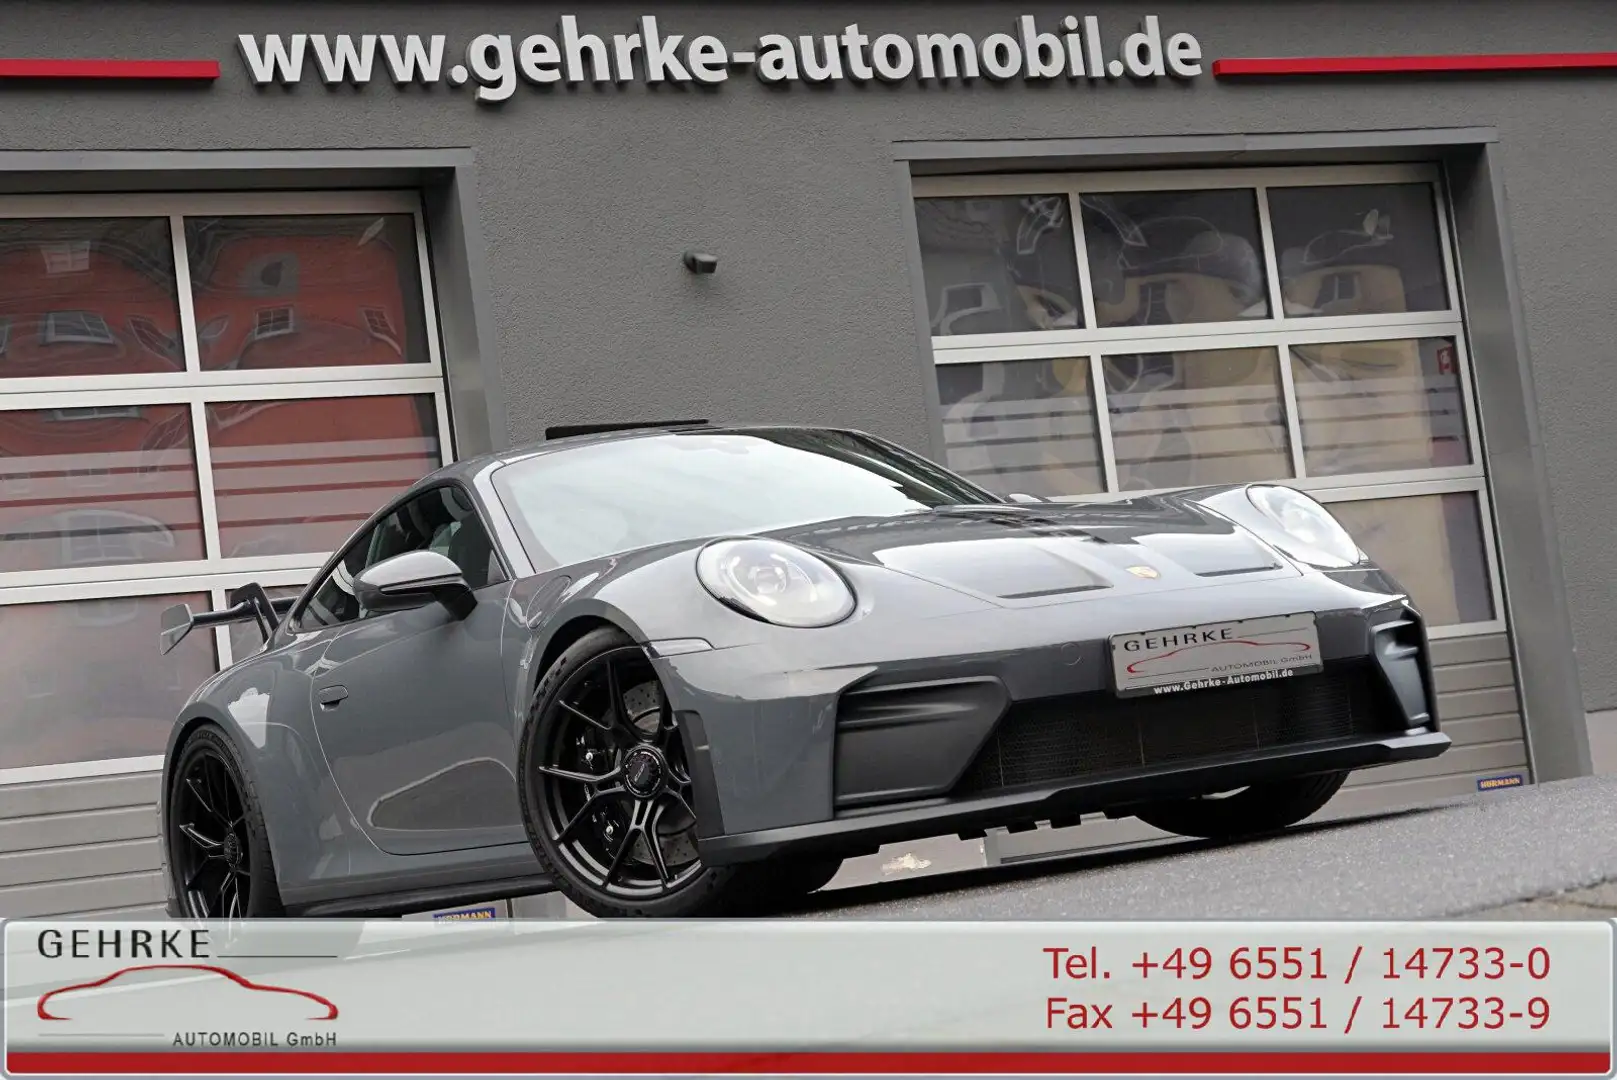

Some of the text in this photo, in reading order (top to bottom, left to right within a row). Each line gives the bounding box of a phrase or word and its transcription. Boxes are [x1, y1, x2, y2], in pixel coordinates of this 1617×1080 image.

[238, 14, 1204, 102] www.gehrke-automobil.de
[1124, 628, 1233, 652] GEHRKE
[1210, 654, 1312, 673] AUTOMOBIL GmbH
[1153, 668, 1294, 694] www.Gehrke-Automobil.de
